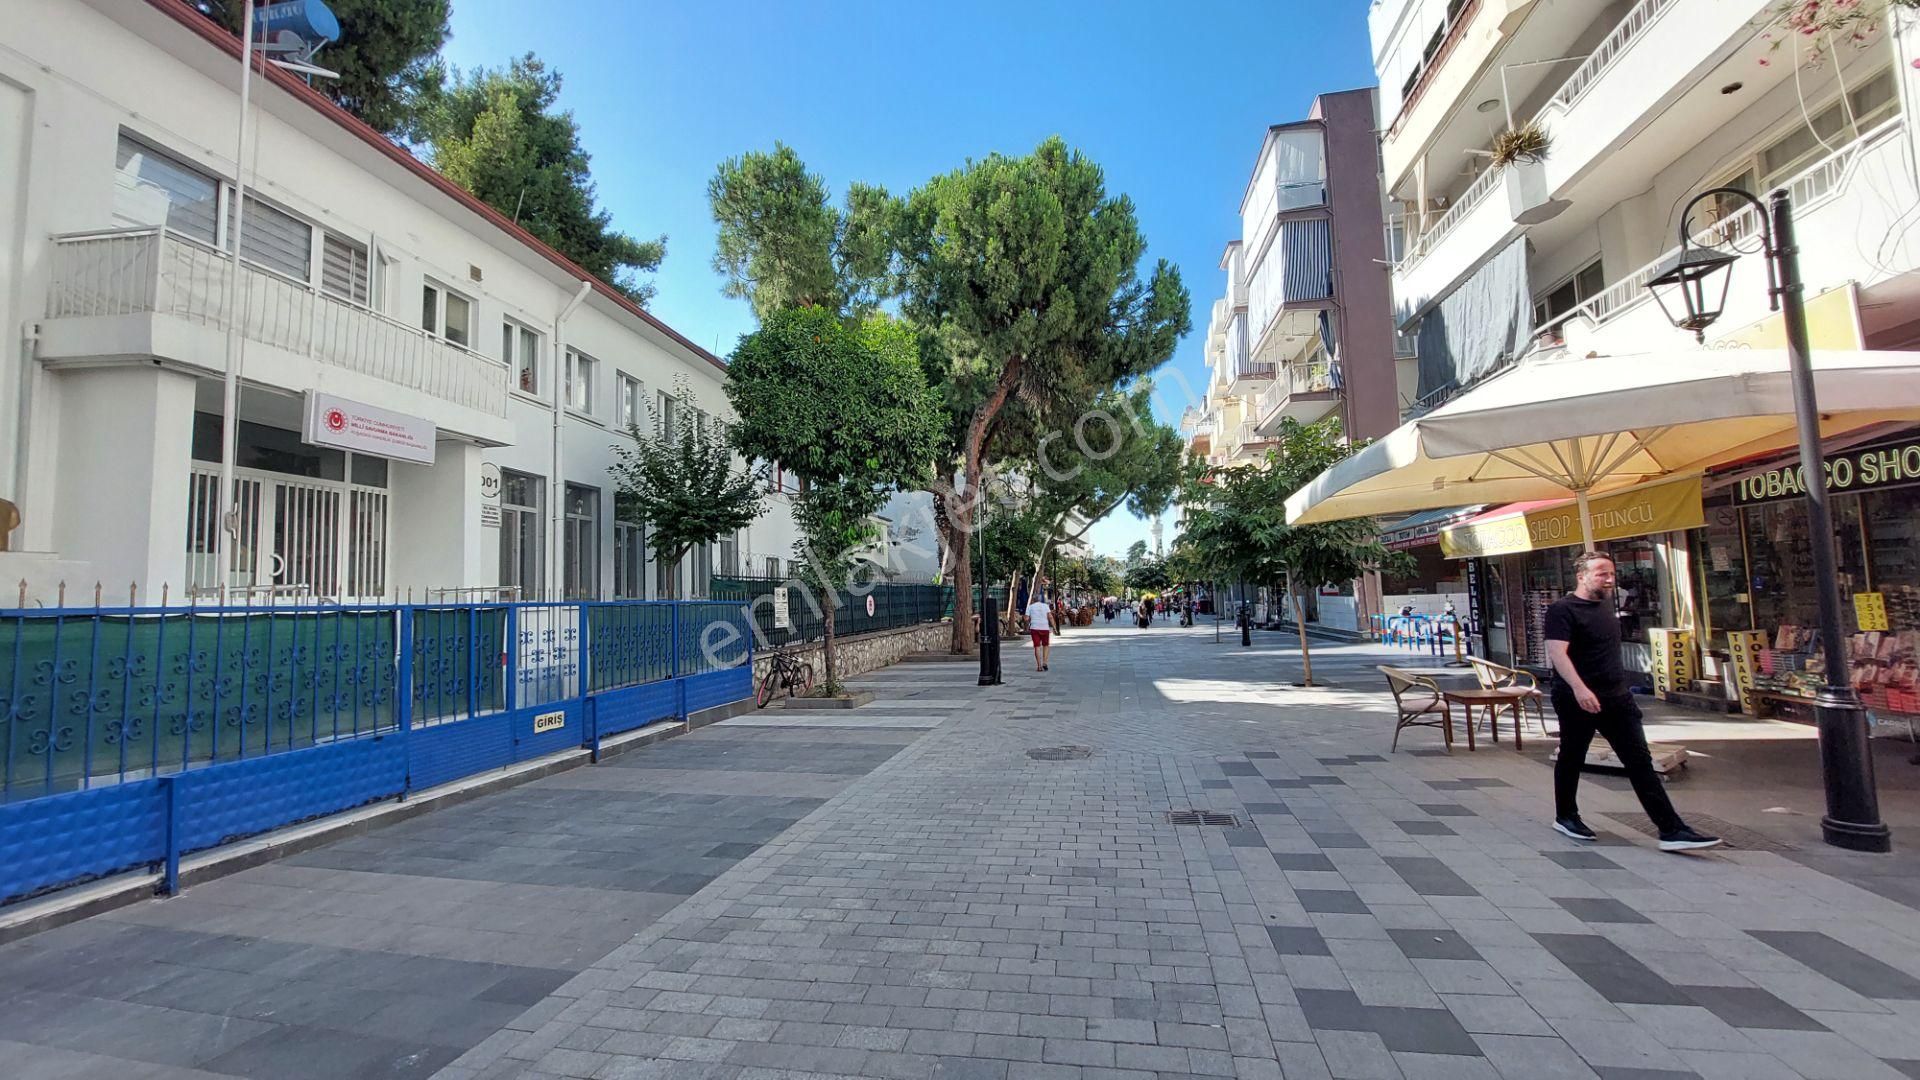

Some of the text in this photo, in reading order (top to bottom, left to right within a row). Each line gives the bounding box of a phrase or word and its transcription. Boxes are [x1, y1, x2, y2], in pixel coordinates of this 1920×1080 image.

[1530, 514, 1570, 543] SHOP
[1671, 632, 1687, 692] TOBACCO
[537, 713, 563, 728] GİRİŞ
